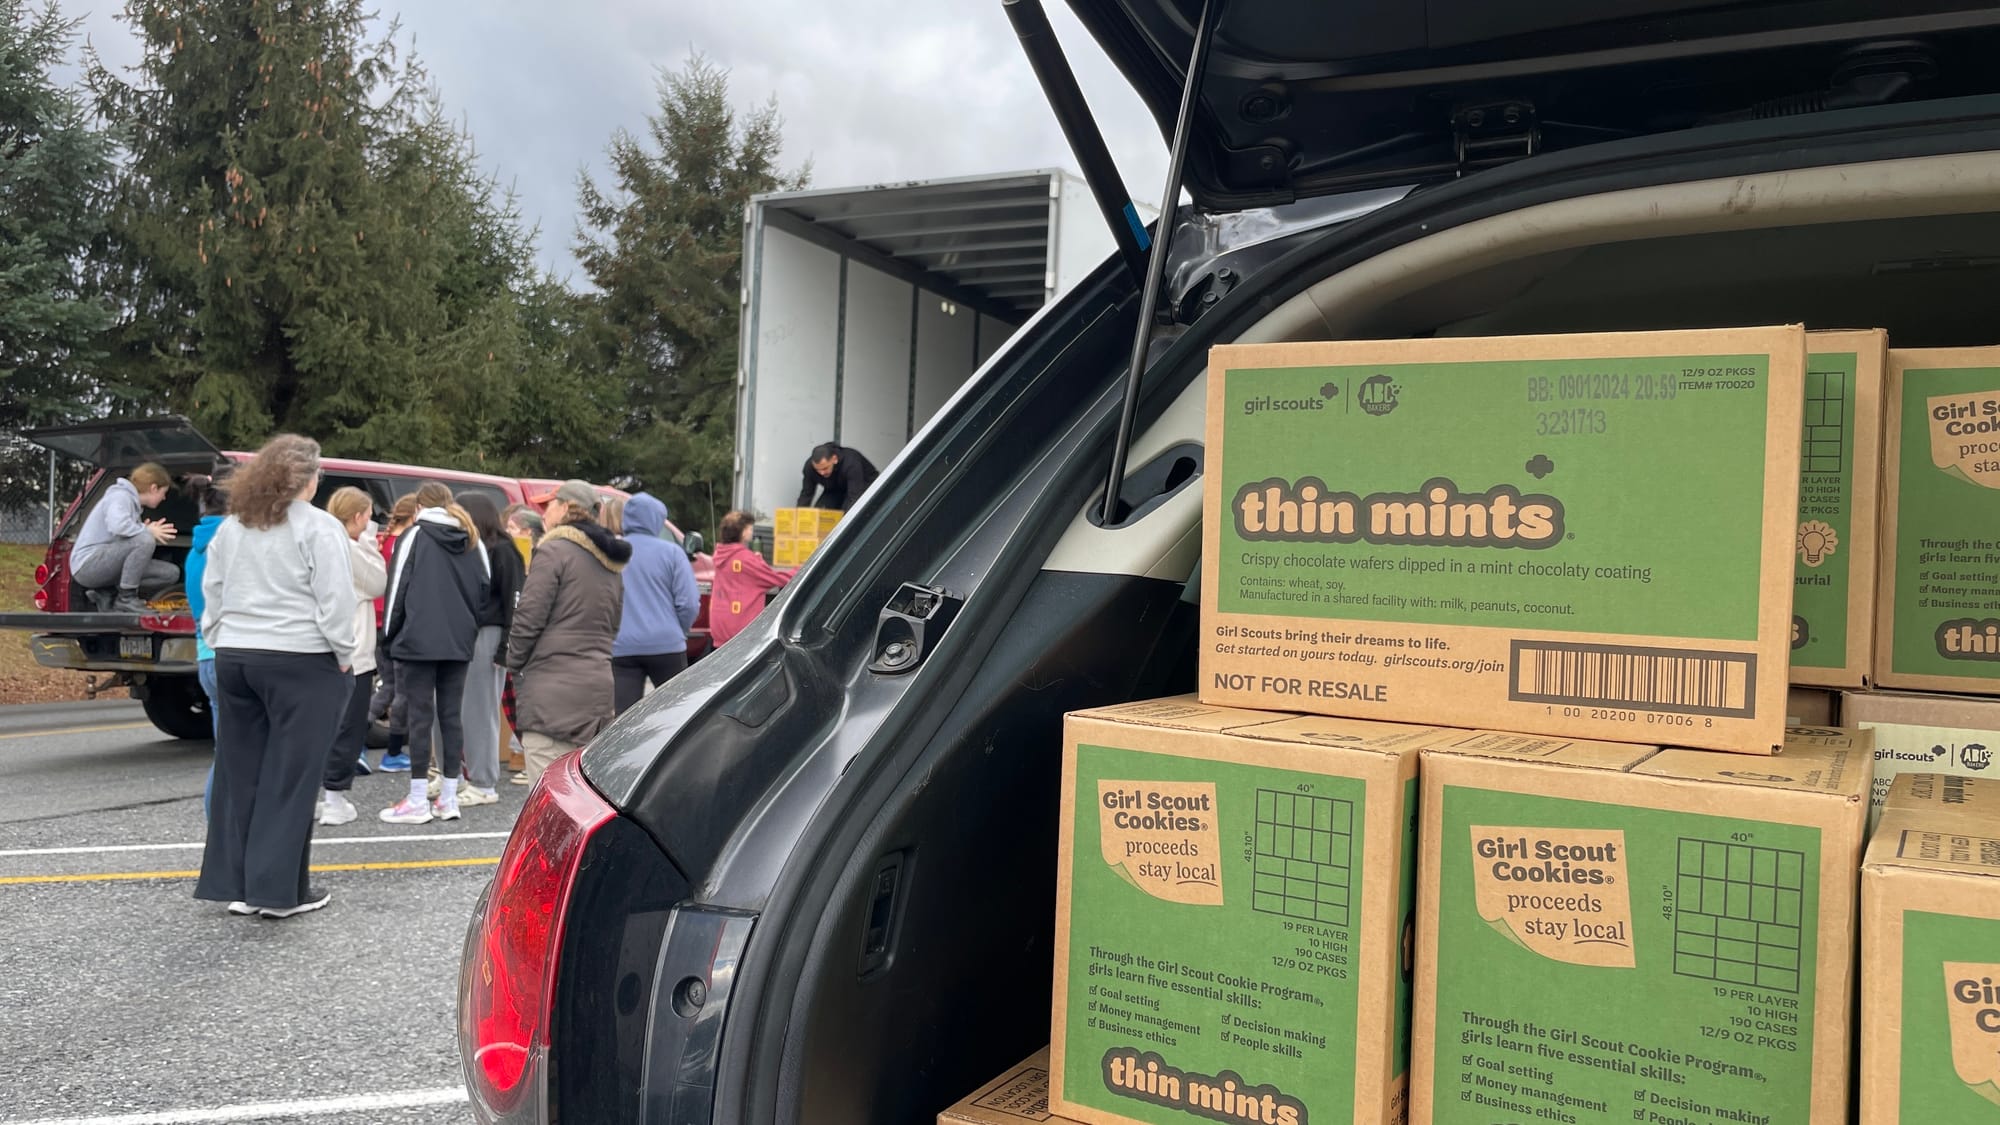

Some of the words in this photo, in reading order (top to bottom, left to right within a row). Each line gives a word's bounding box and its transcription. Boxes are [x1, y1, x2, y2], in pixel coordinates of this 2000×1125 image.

[1682, 368, 1705, 377] 12/9
[1708, 368, 1722, 377] OZ
[1726, 367, 1755, 376] PKGS
[1528, 377, 1553, 401] BB:
[1559, 374, 1629, 400] 09012024
[1635, 373, 1677, 400] 20:59
[1679, 381, 1712, 390] ITEM#
[1716, 380, 1755, 389] 170020
[1244, 396, 1270, 414] girl
[1272, 397, 1324, 411] scouts
[1933, 401, 1976, 420] Girl
[1536, 408, 1606, 435] 3231713
[1240, 487, 1354, 535] thin
[1920, 539, 1968, 551] Through
[1973, 540, 1992, 550] the
[1242, 553, 1280, 568] Crispy
[1284, 553, 1345, 568] chocolate
[1350, 556, 1394, 570] wafers
[1399, 556, 1445, 574] dipped
[1451, 559, 1462, 572] in
[1468, 563, 1475, 573] a
[1481, 560, 1513, 574] mint
[1518, 561, 1590, 580] chocolaty
[1595, 565, 1651, 583] coating
[1920, 553, 1946, 564] girls
[1950, 553, 1981, 563] learn
[1240, 576, 1285, 587] Contains:
[1289, 577, 1322, 590] wheat,
[1326, 582, 1345, 592] soy.
[1932, 572, 1956, 580] Goal
[1960, 572, 1997, 584] setting
[1240, 589, 1308, 601] Manufactured
[1312, 592, 1320, 602] in
[1333, 592, 1368, 604] shared
[1373, 594, 1407, 609] facility
[1410, 596, 1436, 608] with:
[1441, 598, 1466, 612] milk,
[1471, 601, 1520, 614] peanuts,
[1524, 604, 1574, 614] coconut.
[1932, 585, 1967, 597] Money
[1931, 599, 1980, 608] Business
[1216, 626, 1237, 637] Girl
[1241, 628, 1282, 639] Scouts
[1286, 630, 1318, 644] bring
[1321, 632, 1351, 644] their
[1355, 634, 1404, 647] dreams
[1408, 638, 1421, 648] to
[1426, 638, 1450, 650] life.
[1216, 643, 1235, 654] Get
[1238, 645, 1280, 656] started
[1283, 650, 1297, 658] on
[1300, 650, 1335, 661] yours
[1339, 651, 1376, 666] today.
[1384, 654, 1504, 673] girlscouts.org/join
[1215, 673, 1256, 691] NOT
[1262, 677, 1302, 695] FOR
[1309, 680, 1387, 702] RESALE
[1564, 707, 1580, 717] 00
[1591, 709, 1636, 721] 20200
[1647, 713, 1693, 726] 07006
[1704, 718, 1712, 728] 8
[1874, 749, 1893, 760] girl
[1896, 752, 1934, 762] scouts
[1964, 748, 1986, 762] ABC
[1103, 790, 1141, 809] Girl
[1147, 791, 1210, 812] Scout
[1125, 839, 1198, 858] proceeds
[1477, 837, 1527, 860] Girl
[1535, 840, 1616, 862] Scout
[1139, 861, 1172, 881] stay
[1176, 862, 1216, 881] local
[1507, 891, 1601, 913] proceeds
[1283, 922, 1293, 930] 19
[1296, 924, 1314, 934] PER
[1317, 928, 1348, 941] LAYER
[1525, 917, 1568, 940] stay
[1574, 918, 1625, 940] local
[1296, 948, 1312, 958] 190
[1315, 952, 1347, 965] CASES
[1309, 938, 1319, 947] 10
[1323, 940, 1347, 953] HIGH
[1090, 946, 1133, 966] Through
[1137, 956, 1154, 968] the
[1158, 961, 1178, 974] Girl
[1181, 966, 1214, 982] Scout
[1217, 973, 1257, 990] Cookie
[1272, 956, 1295, 968] 12/9
[1298, 962, 1313, 972] OZ
[1317, 965, 1347, 978] PKGS
[1088, 963, 1112, 976] girls
[1116, 967, 1144, 983] learn
[1148, 974, 1168, 988] five
[1171, 982, 1223, 1000] essential
[1226, 992, 1261, 1009] skills:
[1100, 988, 1122, 1000] Goal
[1125, 995, 1160, 1011] setting
[1714, 987, 1726, 996] 19
[1731, 990, 1754, 1002] PER
[1758, 994, 1798, 1009] LAYER
[1100, 1003, 1132, 1021] Money
[1135, 1013, 1200, 1035] management
[1748, 1006, 1761, 1016] 10
[1765, 1008, 1797, 1022] HIGH
[1099, 1020, 1142, 1038] Business
[1146, 1032, 1176, 1046] ethics
[1234, 1017, 1280, 1036] Decision
[1284, 1030, 1326, 1049] making
[1730, 1016, 1752, 1028] 190
[1756, 1021, 1797, 1036] CASES
[1234, 1034, 1269, 1050] People
[1272, 1043, 1302, 1058] skills
[1462, 1012, 1518, 1034] Through
[1524, 1023, 1546, 1038] the
[1550, 1029, 1576, 1044] Girl
[1581, 1035, 1624, 1053] Scout
[1628, 1044, 1680, 1064] Cookie
[1700, 1026, 1730, 1039] 12/9
[1734, 1032, 1753, 1044] OZ
[1758, 1036, 1796, 1052] PKGS
[1461, 1030, 1492, 1045] girls
[1497, 1035, 1532, 1054] learn
[1537, 1044, 1564, 1060] five
[1568, 1054, 1636, 1074] essential
[1640, 1065, 1685, 1084] skills:
[1477, 1057, 1504, 1072] Goal
[1508, 1066, 1553, 1085] setting
[1111, 1057, 1180, 1100] thin
[1189, 1080, 1299, 1125] mints
[1476, 1075, 1517, 1095] Money
[1522, 1087, 1607, 1112] management
[1476, 1093, 1532, 1114] Business
[1536, 1108, 1575, 1124] ethics
[1651, 1093, 1710, 1114] Decision
